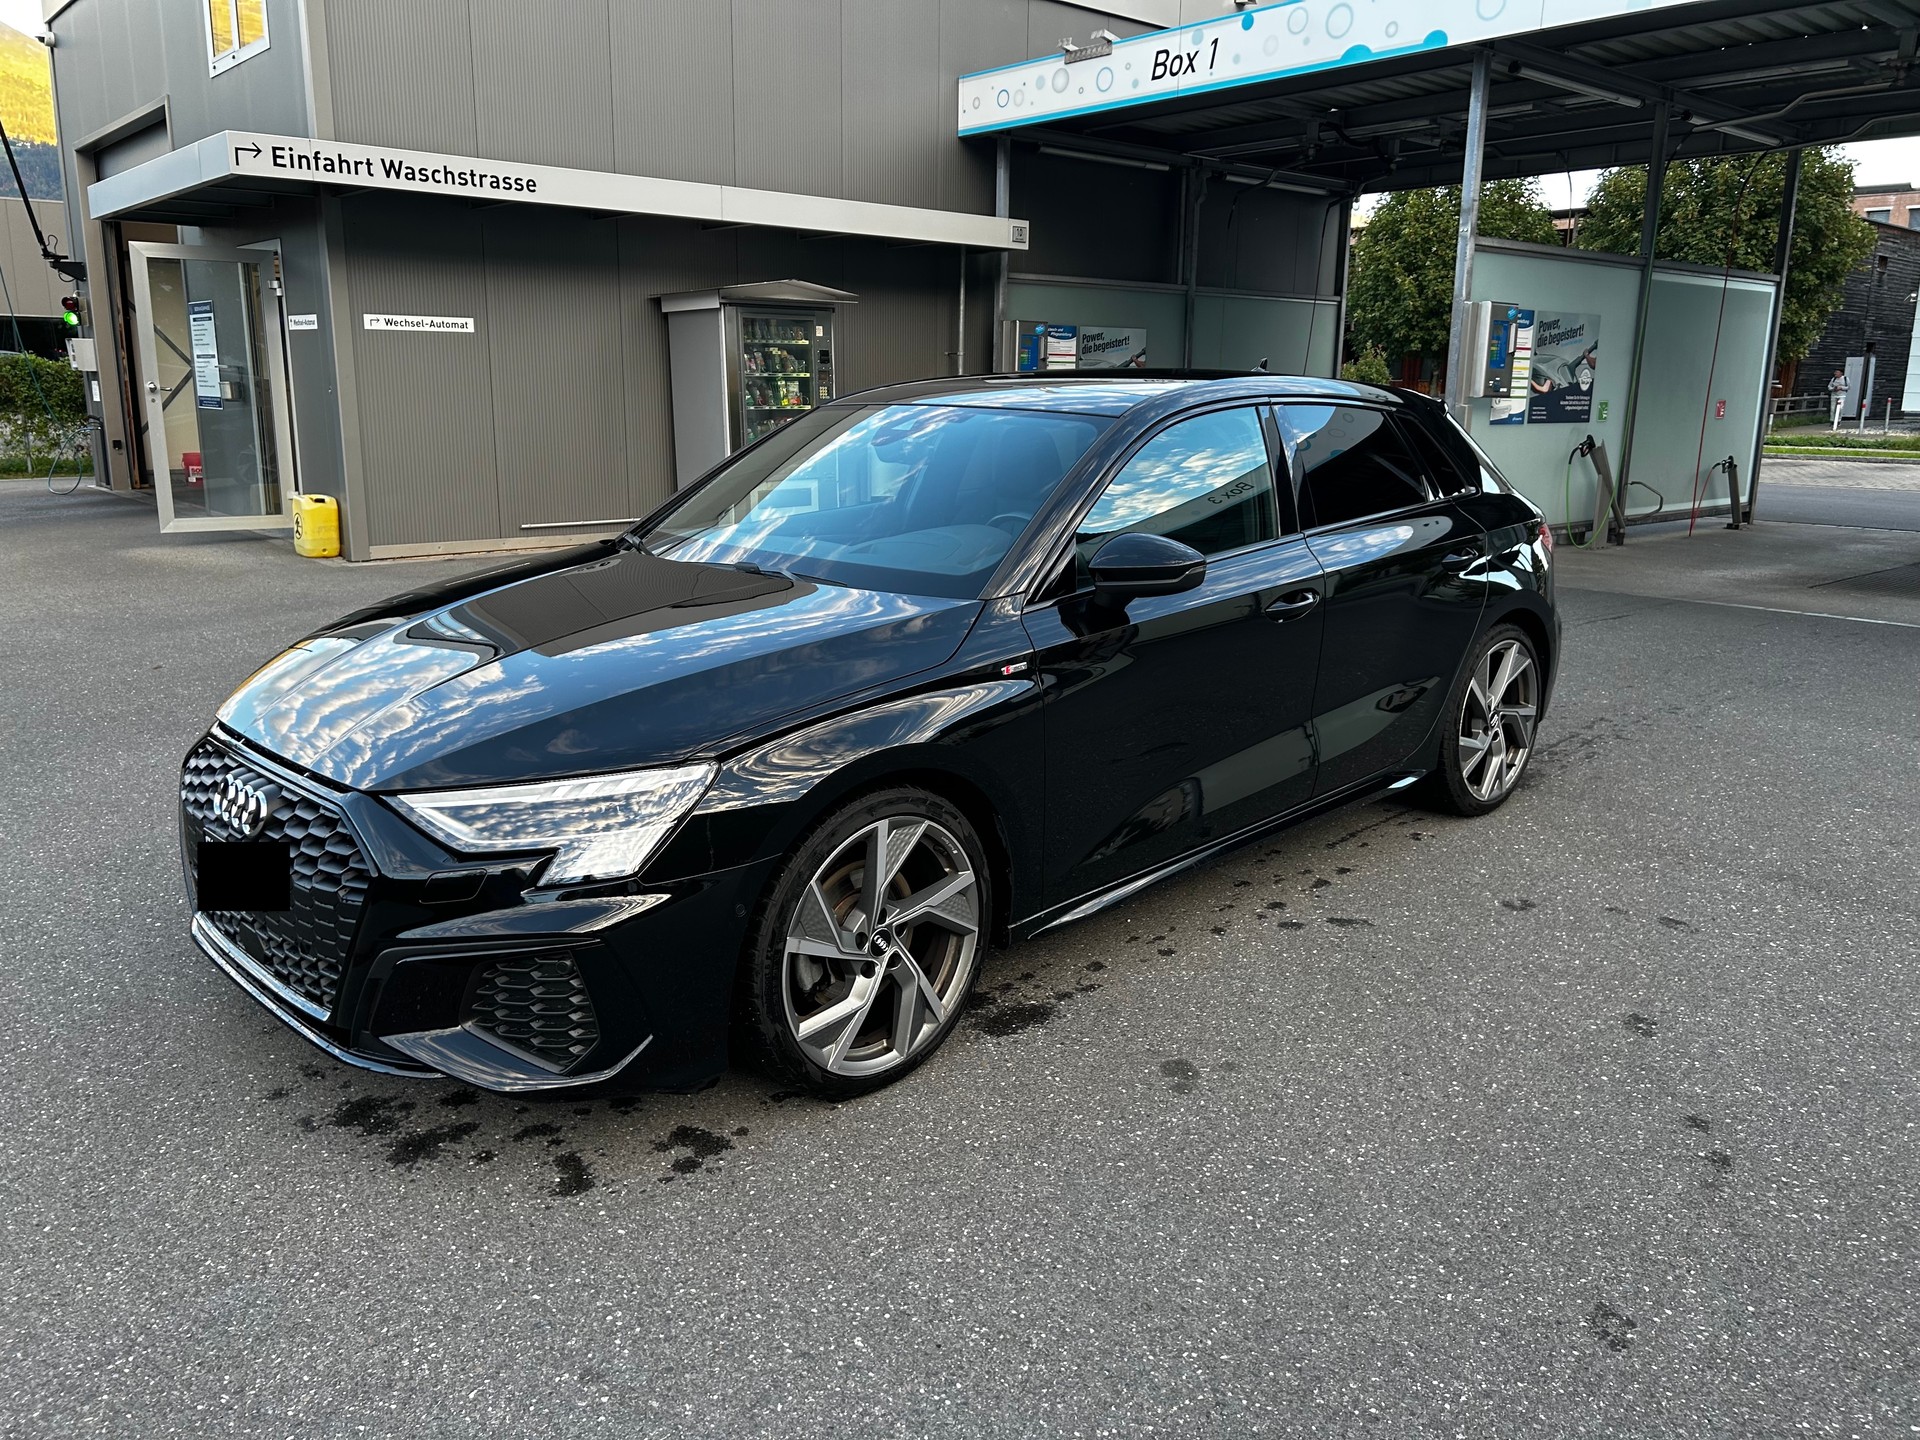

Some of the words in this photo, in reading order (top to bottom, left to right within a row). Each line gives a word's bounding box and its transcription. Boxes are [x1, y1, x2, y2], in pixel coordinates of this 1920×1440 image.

[1151, 49, 1200, 81] Box
[1209, 37, 1219, 70] 1
[271, 145, 374, 177] Einfahrt
[380, 157, 537, 193] Waschstrasse
[384, 317, 469, 330] Wechsel-Automat
[1539, 319, 1560, 333] Power,
[1082, 331, 1105, 344] Power,
[1082, 343, 1092, 354] die
[1093, 335, 1130, 353] begeistert!
[1537, 333, 1548, 347] die
[1549, 324, 1584, 345] begeistert!
